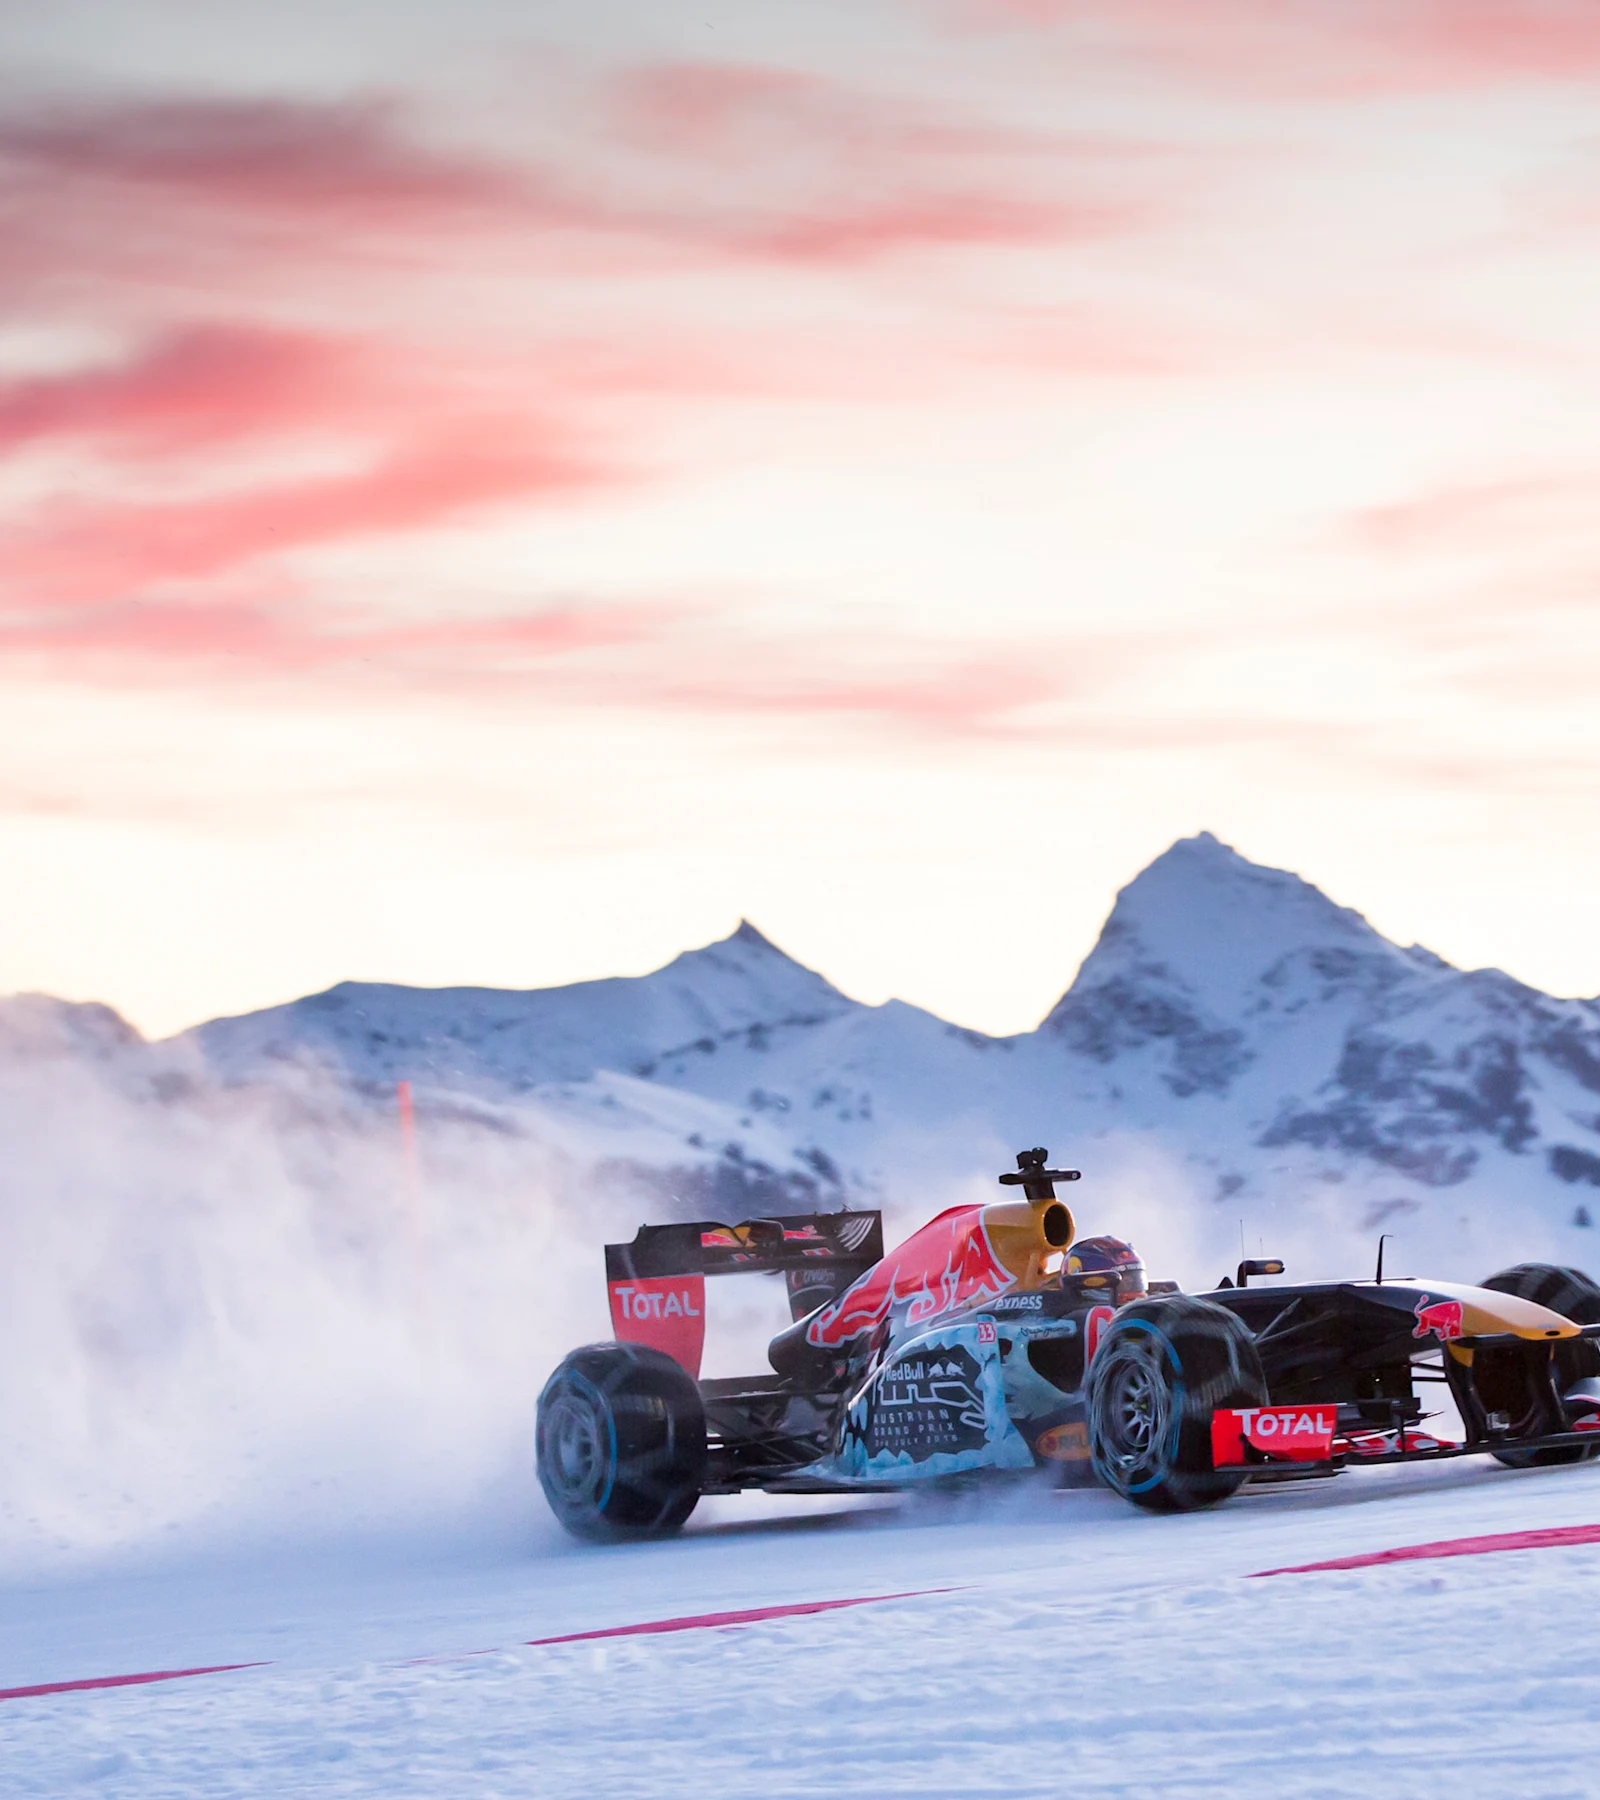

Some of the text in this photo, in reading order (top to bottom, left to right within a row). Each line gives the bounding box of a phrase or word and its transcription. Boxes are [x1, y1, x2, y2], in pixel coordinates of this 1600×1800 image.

[979, 1323, 995, 1341] 33
[886, 1361, 924, 1381] Red Bull
[873, 1409, 949, 1424] AUSTRIAN
[874, 1422, 954, 1437] GRAND PRIX
